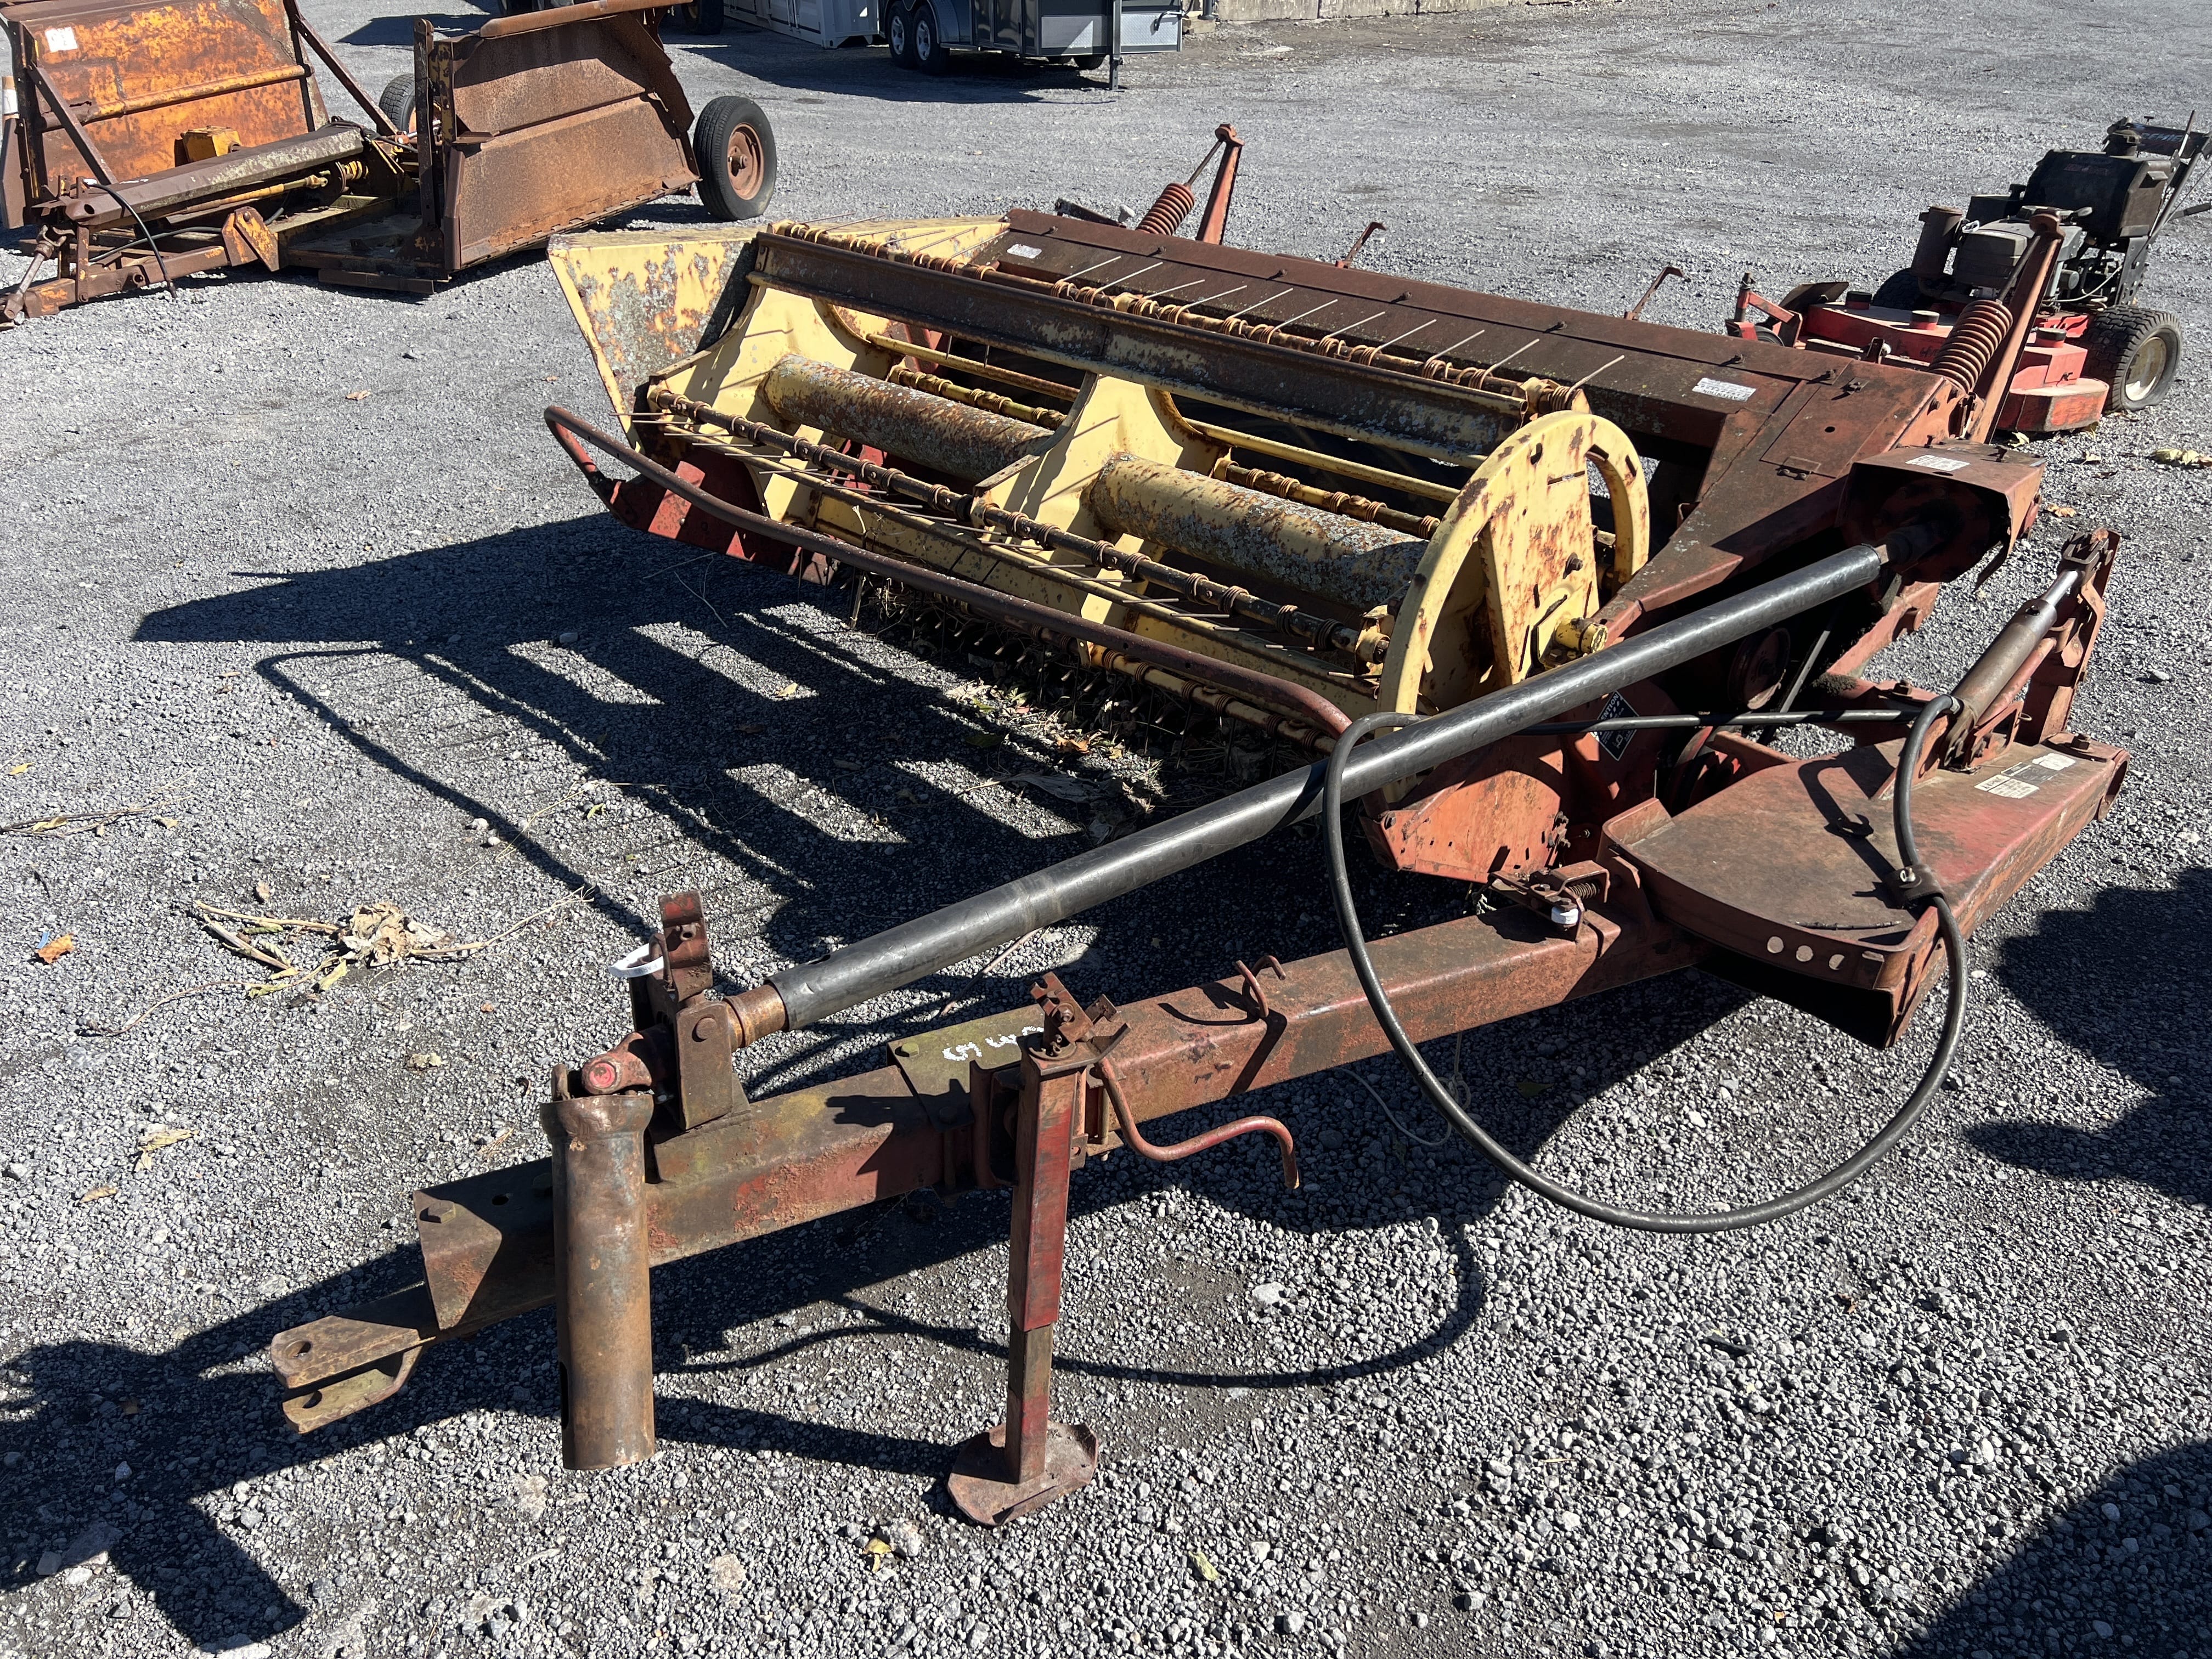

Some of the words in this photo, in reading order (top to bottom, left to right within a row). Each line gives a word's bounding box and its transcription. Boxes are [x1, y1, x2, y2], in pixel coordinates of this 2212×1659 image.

[2142, 132, 2184, 143] REMIE
[1702, 389, 1737, 400] ATTENTION
[1600, 693, 1620, 720] ENTION
